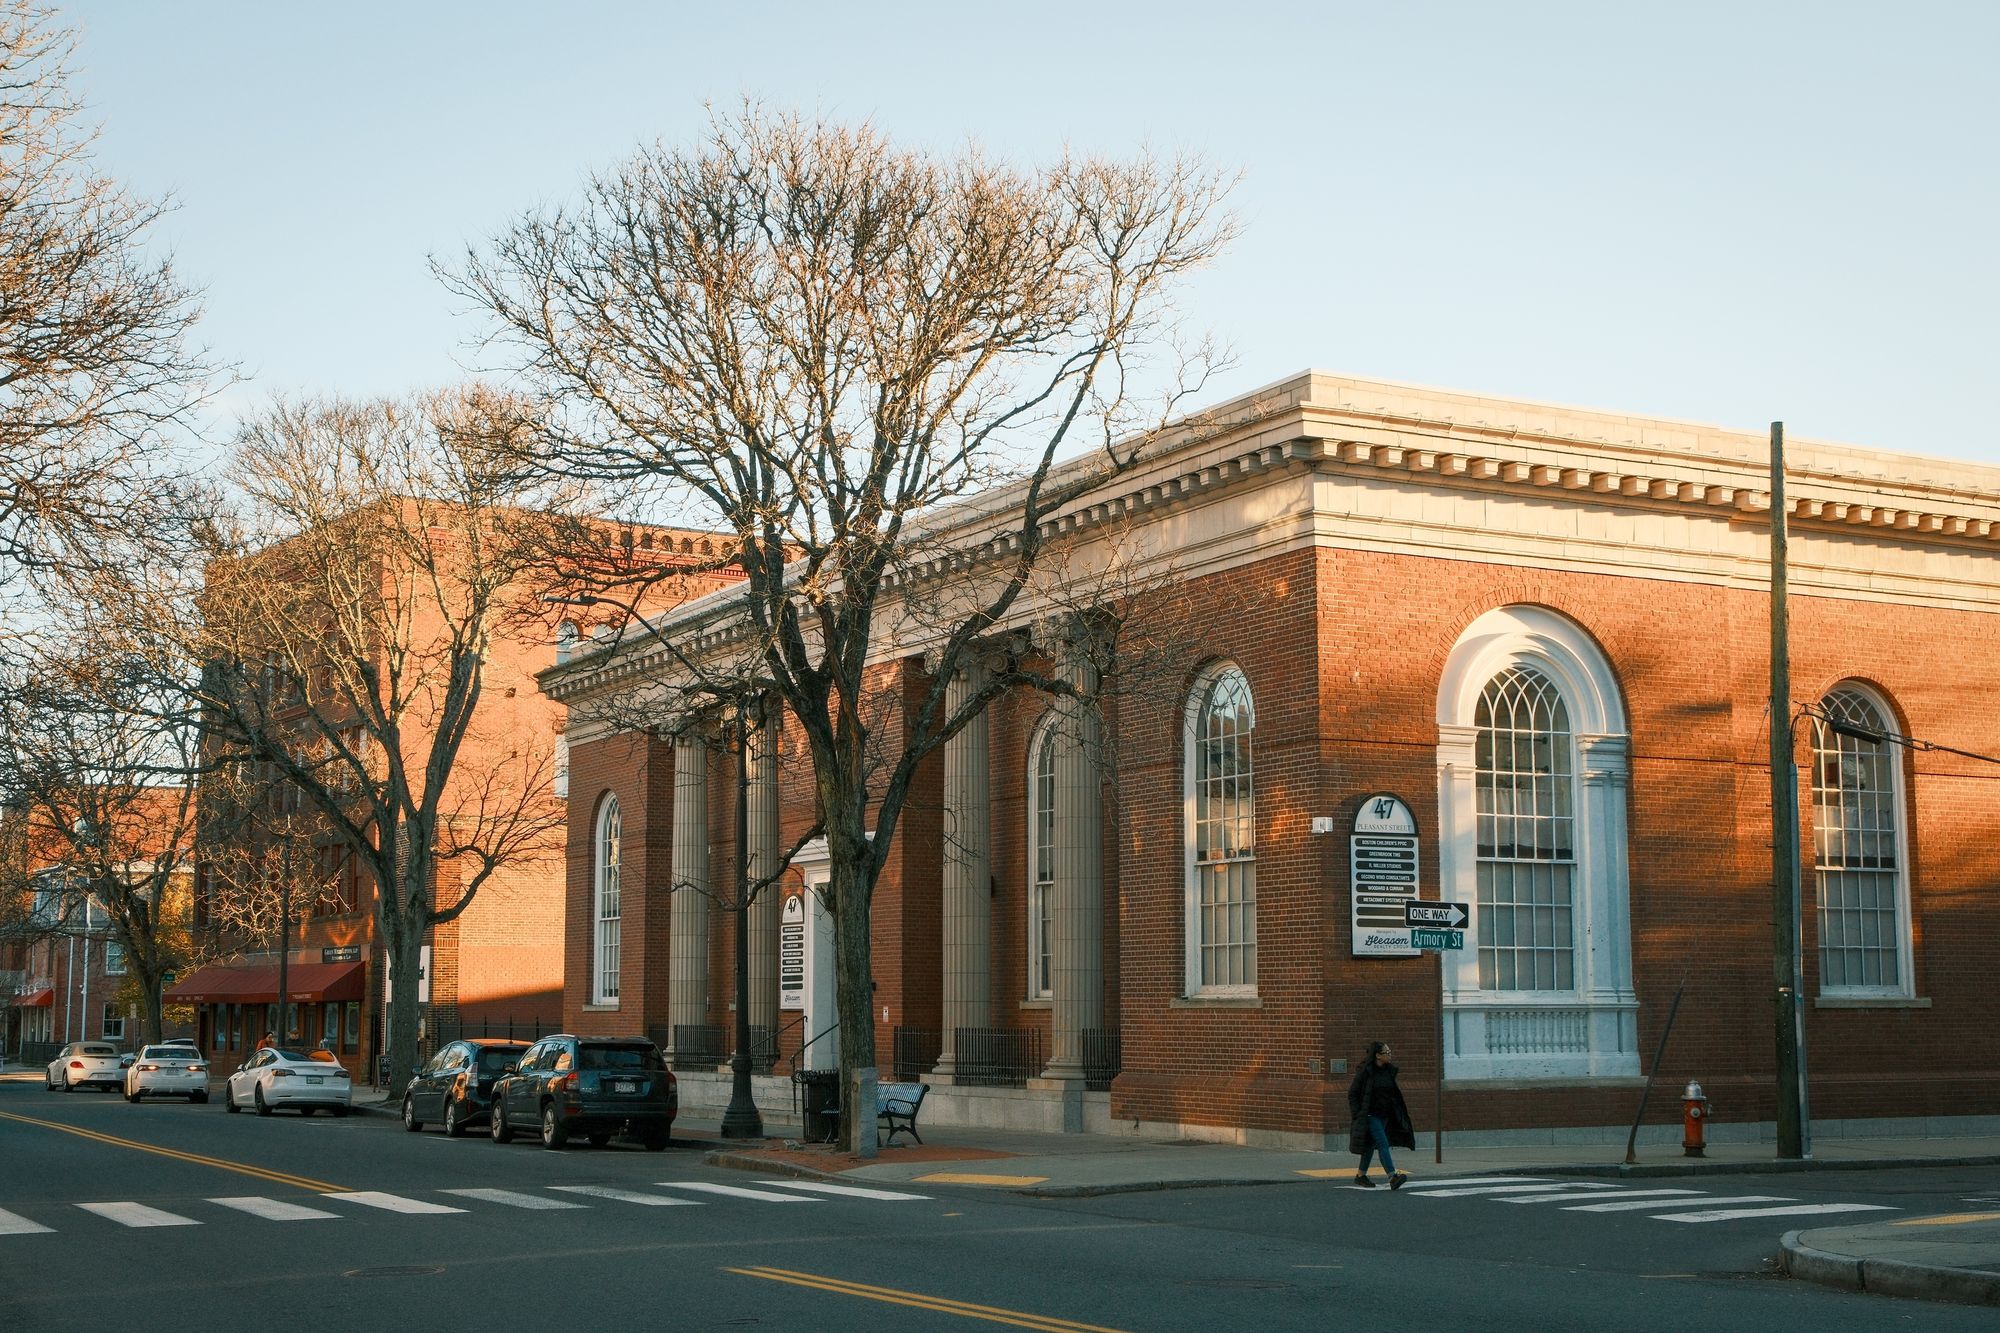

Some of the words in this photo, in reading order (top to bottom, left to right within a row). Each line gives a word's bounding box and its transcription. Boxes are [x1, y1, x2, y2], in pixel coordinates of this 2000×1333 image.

[1374, 798, 1395, 819] 47
[1357, 823, 1388, 831] PLEASANT
[1389, 824, 1411, 832] STREET
[787, 898, 797, 914] 47
[1411, 908, 1429, 919] ONE
[1432, 909, 1449, 920] WAY
[1364, 935, 1408, 946] Gleason
[1413, 930, 1446, 948] Armory
[1451, 932, 1461, 947] St
